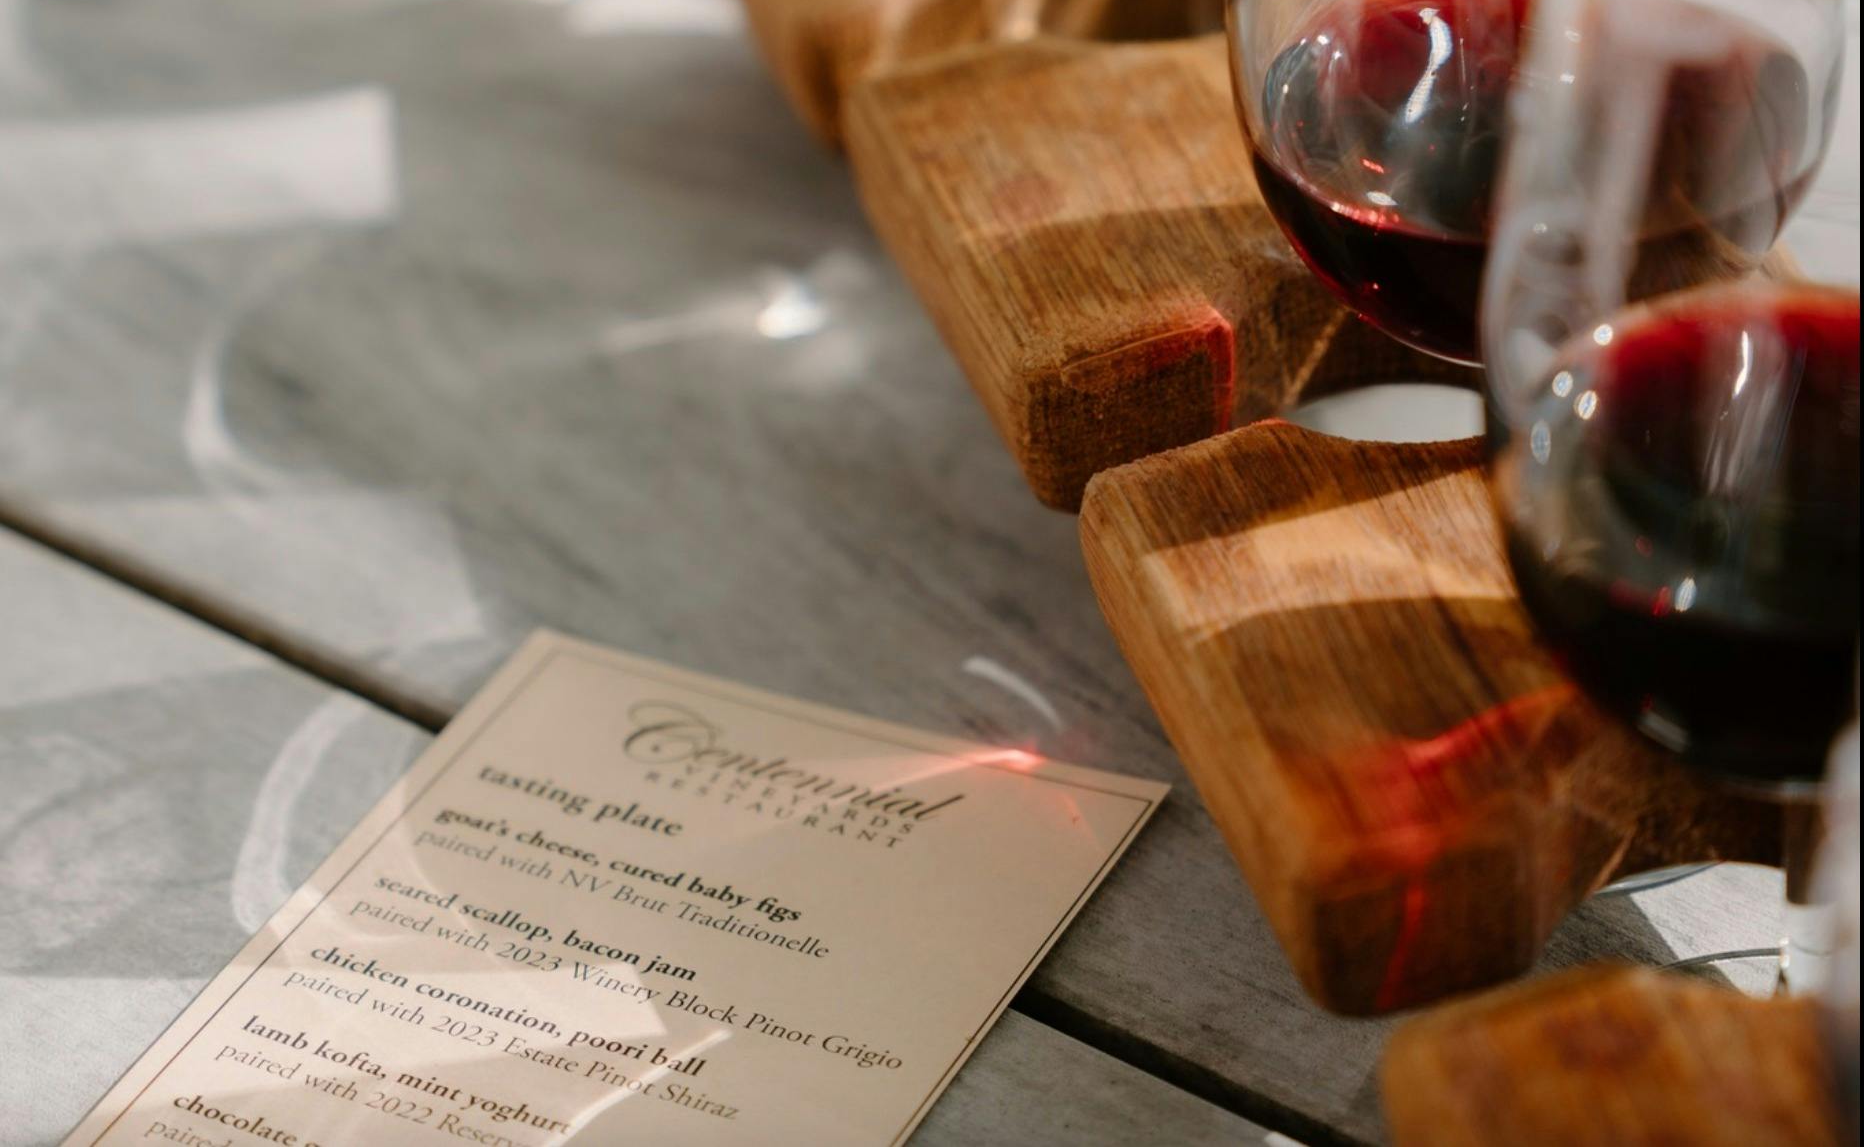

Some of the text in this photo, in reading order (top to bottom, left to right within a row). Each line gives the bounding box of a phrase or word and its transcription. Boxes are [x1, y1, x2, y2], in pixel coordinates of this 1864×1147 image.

[477, 764, 683, 838] tasting plate
[624, 700, 964, 821] Centennial
[644, 770, 903, 850] RESTAURANT
[684, 763, 914, 835] VINEYARDS
[413, 830, 830, 959] paired with NV Brut Traditionelle
[434, 809, 802, 923] goat's cheese, cured baby figs
[349, 901, 903, 1070] paired with 2023 Winery Block Pinot Grigio
[374, 877, 697, 982] seared scallop, bacon jam
[283, 971, 740, 1121] paired with 2023 Estate Pinot Shiraz
[310, 947, 708, 1077] chicken coronation, poori ball
[173, 1095, 298, 1147] chocolate
[214, 1045, 302, 1080] paired
[304, 1073, 359, 1102] with
[365, 1092, 434, 1124] 2022
[241, 1015, 571, 1135] lamb kofta, mint yoghurt
